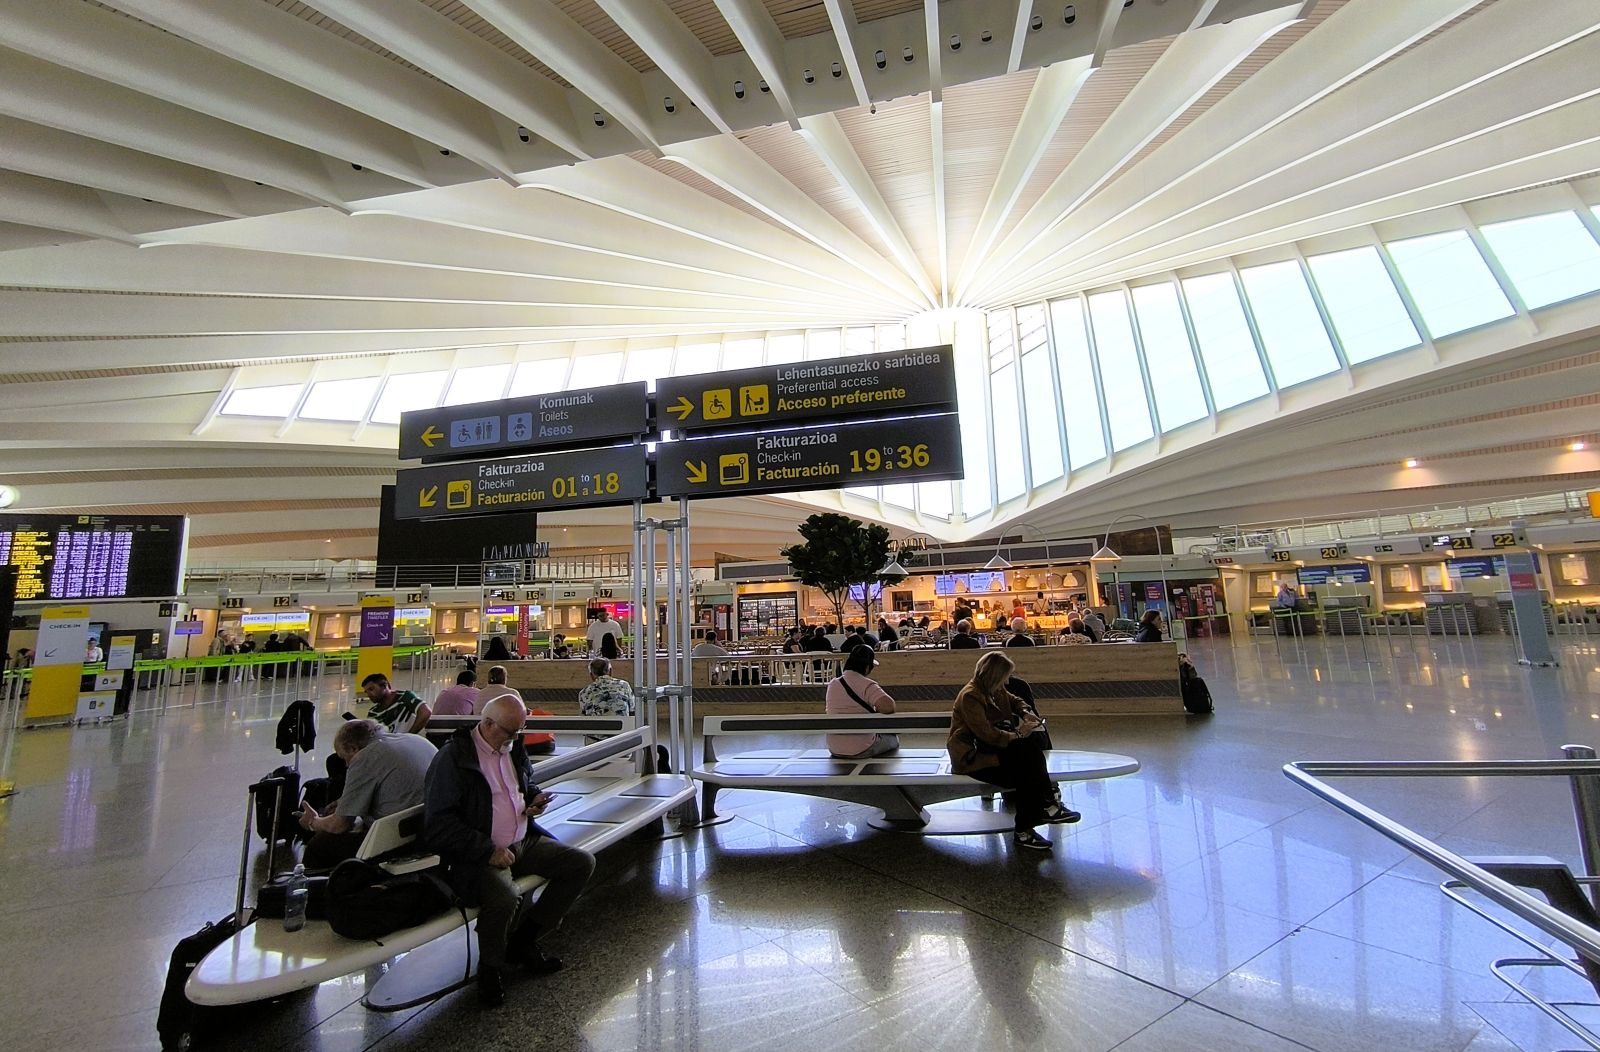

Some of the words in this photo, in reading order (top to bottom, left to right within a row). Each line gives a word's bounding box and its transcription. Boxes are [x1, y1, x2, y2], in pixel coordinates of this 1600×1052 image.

[777, 360, 880, 381] Lehentasunezko
[885, 352, 940, 369] sarbidea
[777, 378, 837, 394] Preferential
[841, 375, 879, 388] access
[539, 392, 593, 409] Komunak
[777, 395, 826, 411] Acceso
[831, 387, 906, 408] preferente
[540, 410, 569, 422] Toilets
[539, 425, 573, 437] Aseos
[757, 432, 837, 450] Fakturazioa
[757, 450, 801, 464] Check-in
[850, 449, 881, 473] 19
[883, 446, 893, 455] to
[896, 444, 929, 468] 36
[478, 460, 545, 476] Fakturazioa
[885, 460, 893, 470] a
[757, 462, 840, 481] Facturación
[478, 477, 515, 490] Check-in
[552, 476, 578, 498] 01
[581, 474, 590, 483] to
[593, 472, 620, 495] 18
[477, 489, 545, 505] Facturación
[582, 487, 589, 496] a
[1453, 538, 1471, 549] 21
[1494, 535, 1514, 546] 22
[1275, 552, 1289, 561] 19
[1321, 548, 1338, 558] 20
[408, 594, 421, 602] 14
[502, 592, 514, 600] 15
[601, 590, 612, 598] 17
[227, 599, 241, 607] 11
[276, 598, 288, 606] 12
